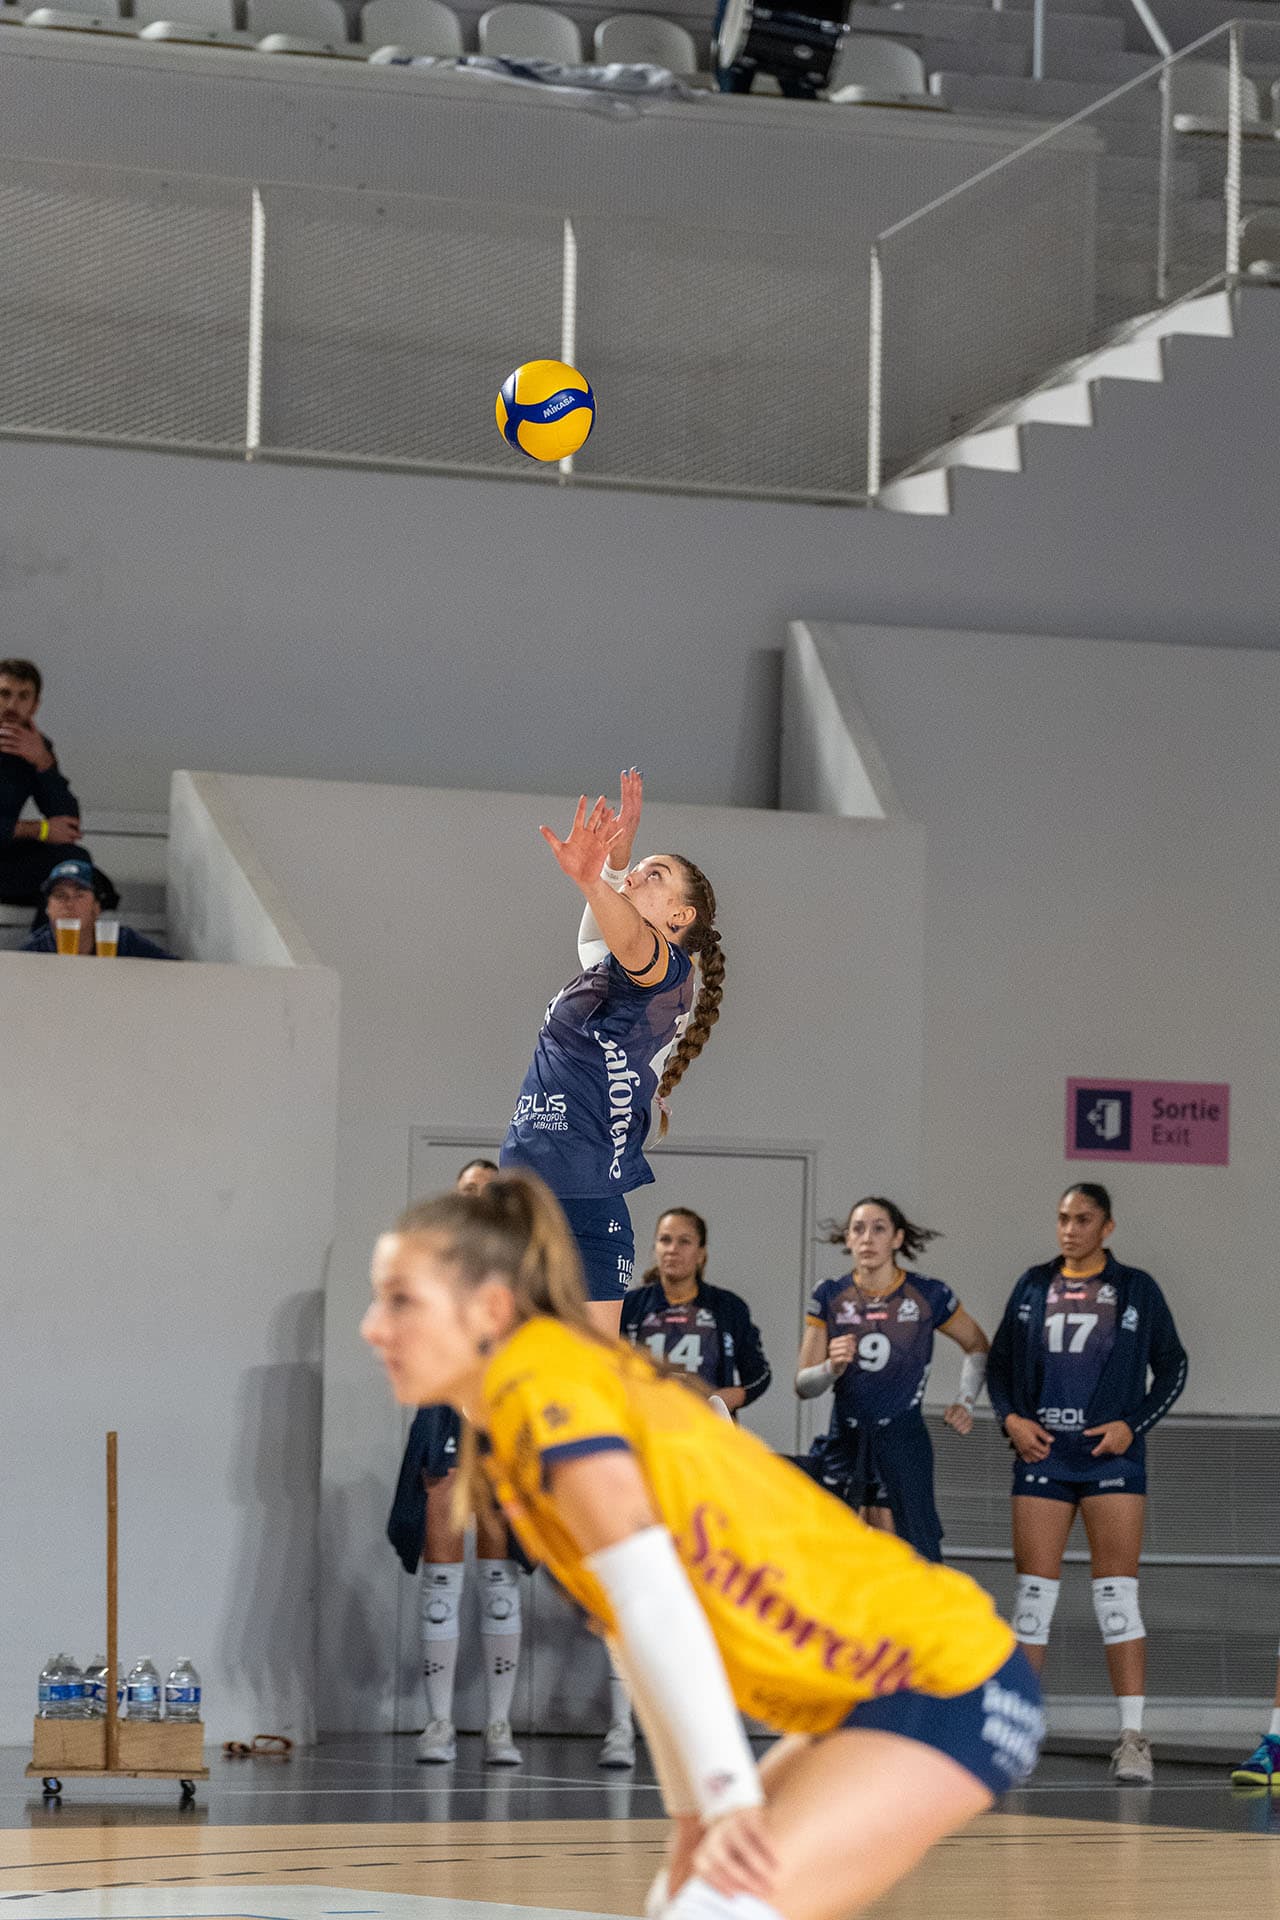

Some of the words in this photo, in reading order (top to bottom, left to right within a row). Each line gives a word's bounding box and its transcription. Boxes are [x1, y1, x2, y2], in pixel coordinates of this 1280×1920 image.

[1152, 1099, 1220, 1121] Sortie
[1152, 1125, 1191, 1146] Exit
[645, 1332, 704, 1374] 14
[858, 1332, 891, 1373] 9
[1044, 1312, 1099, 1353] 17
